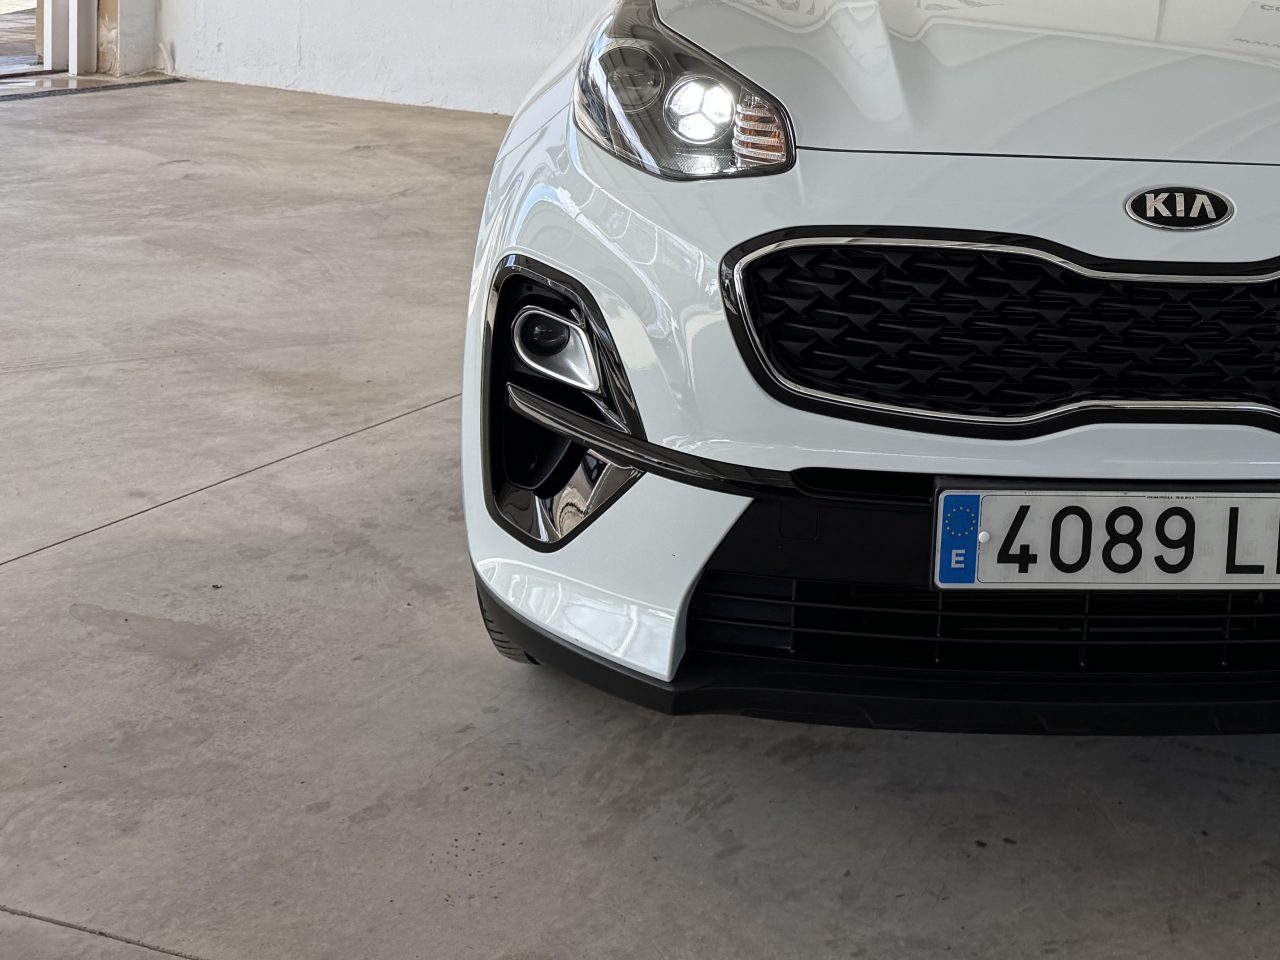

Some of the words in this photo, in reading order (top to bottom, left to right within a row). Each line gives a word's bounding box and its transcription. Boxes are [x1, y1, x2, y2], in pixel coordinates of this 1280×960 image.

[1145, 192, 1217, 219] KIA
[996, 505, 1196, 574] 4089
[951, 549, 966, 568] E
